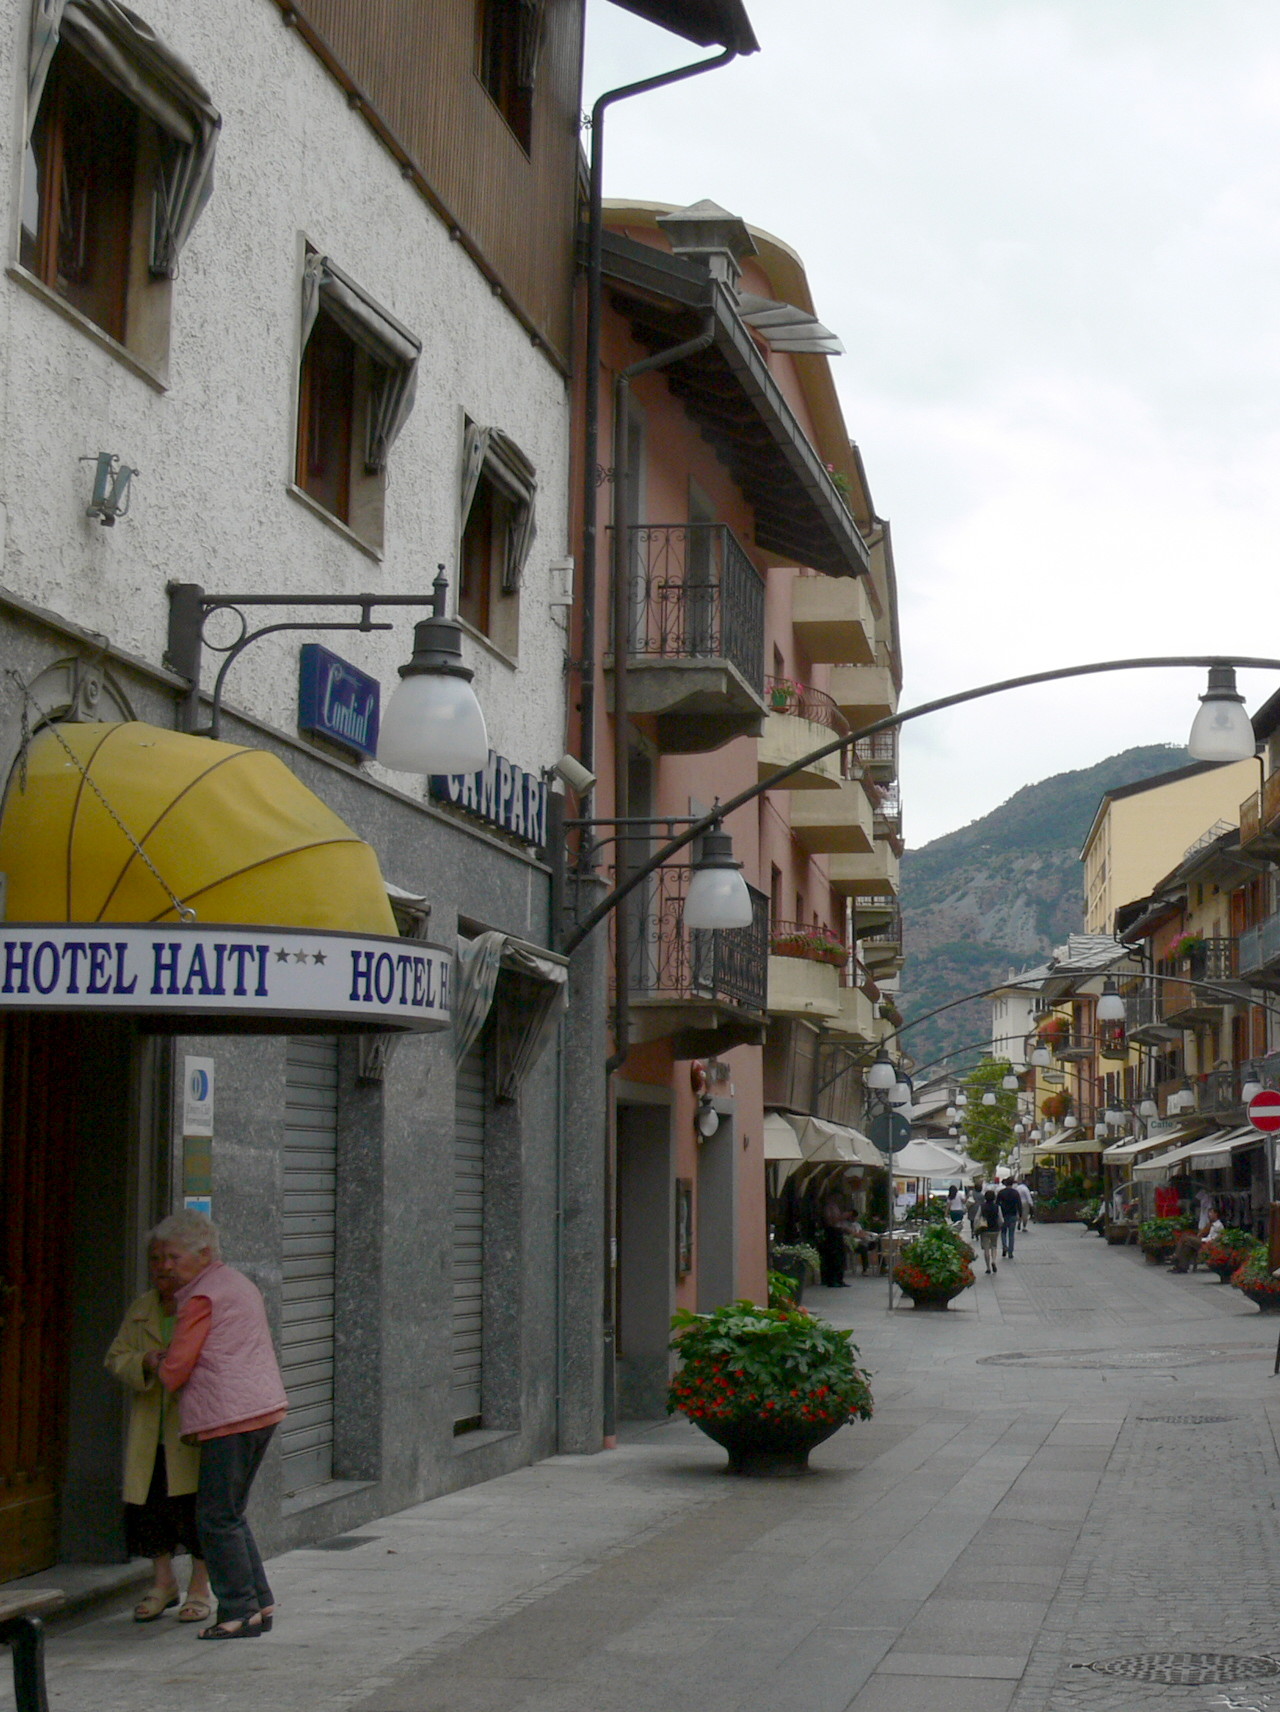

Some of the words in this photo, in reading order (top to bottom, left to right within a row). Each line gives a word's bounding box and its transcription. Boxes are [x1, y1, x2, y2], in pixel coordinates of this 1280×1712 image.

[2, 941, 138, 995] HOTEL
[150, 943, 270, 997] HAITI
[350, 950, 436, 1008] HOTEL
